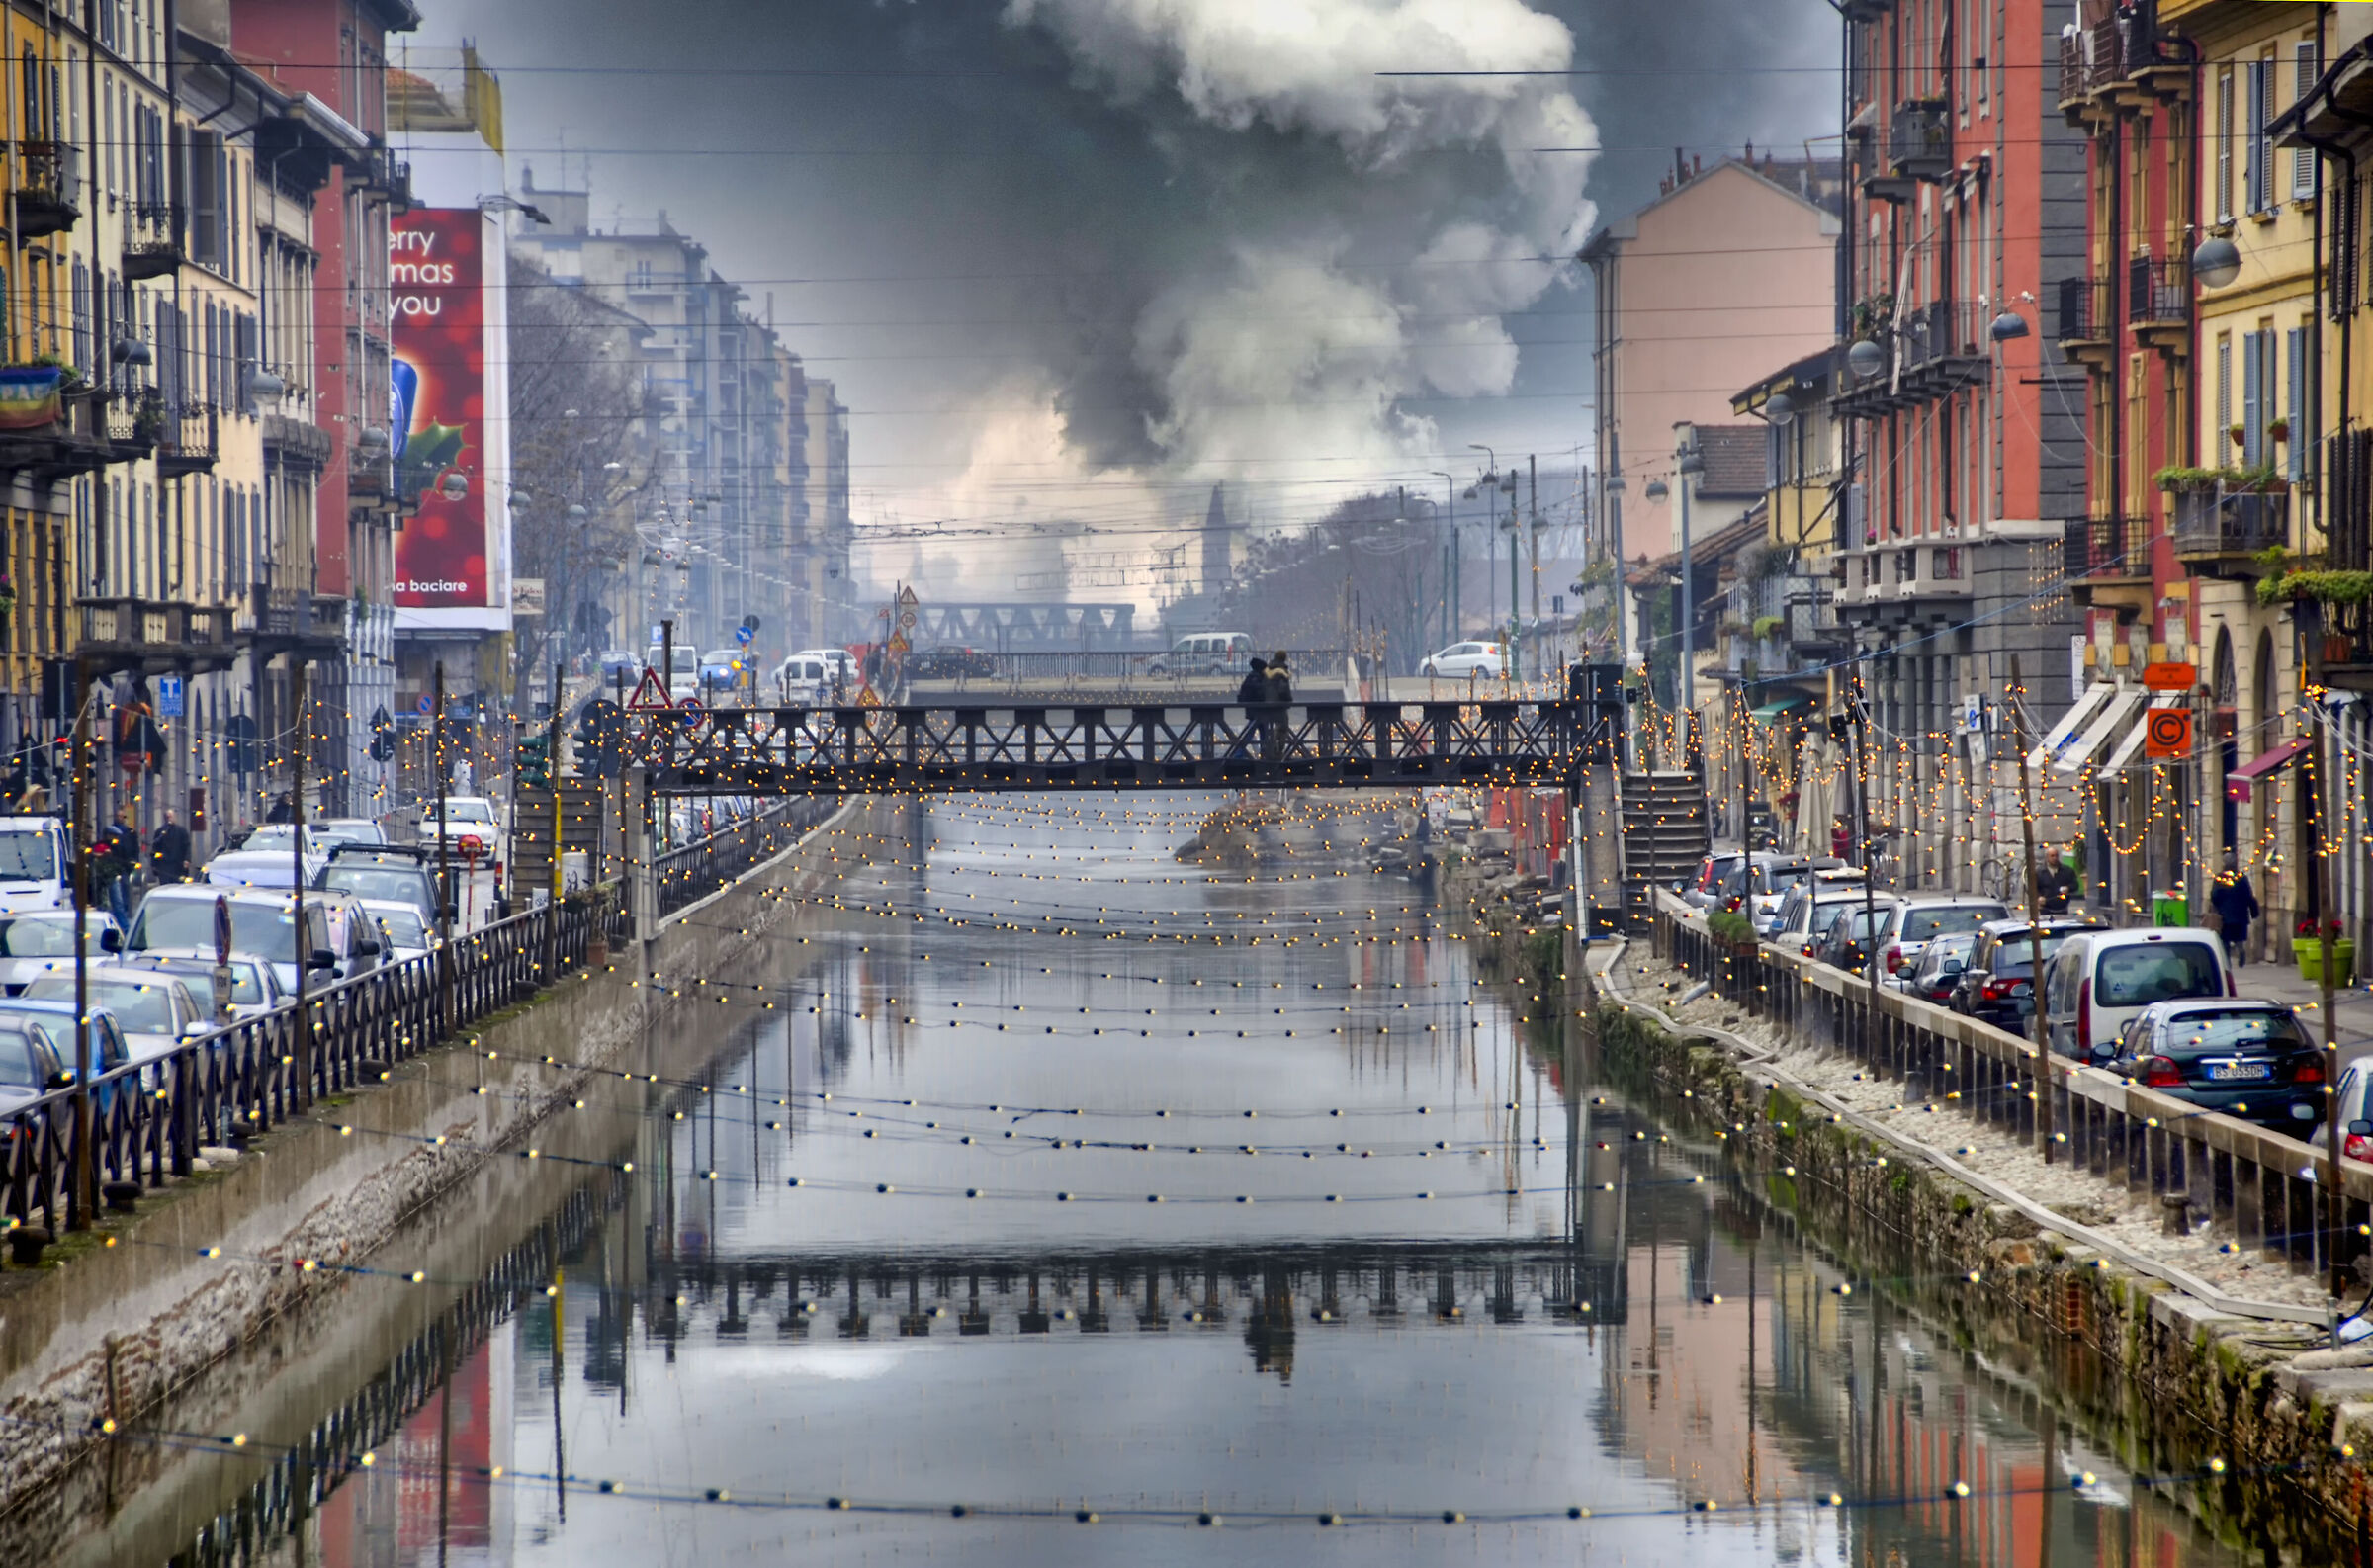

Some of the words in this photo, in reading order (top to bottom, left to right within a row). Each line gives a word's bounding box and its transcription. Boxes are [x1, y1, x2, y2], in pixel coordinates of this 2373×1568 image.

[390, 296, 440, 319] you
[409, 579, 467, 592] baciare
[163, 678, 178, 698] T
